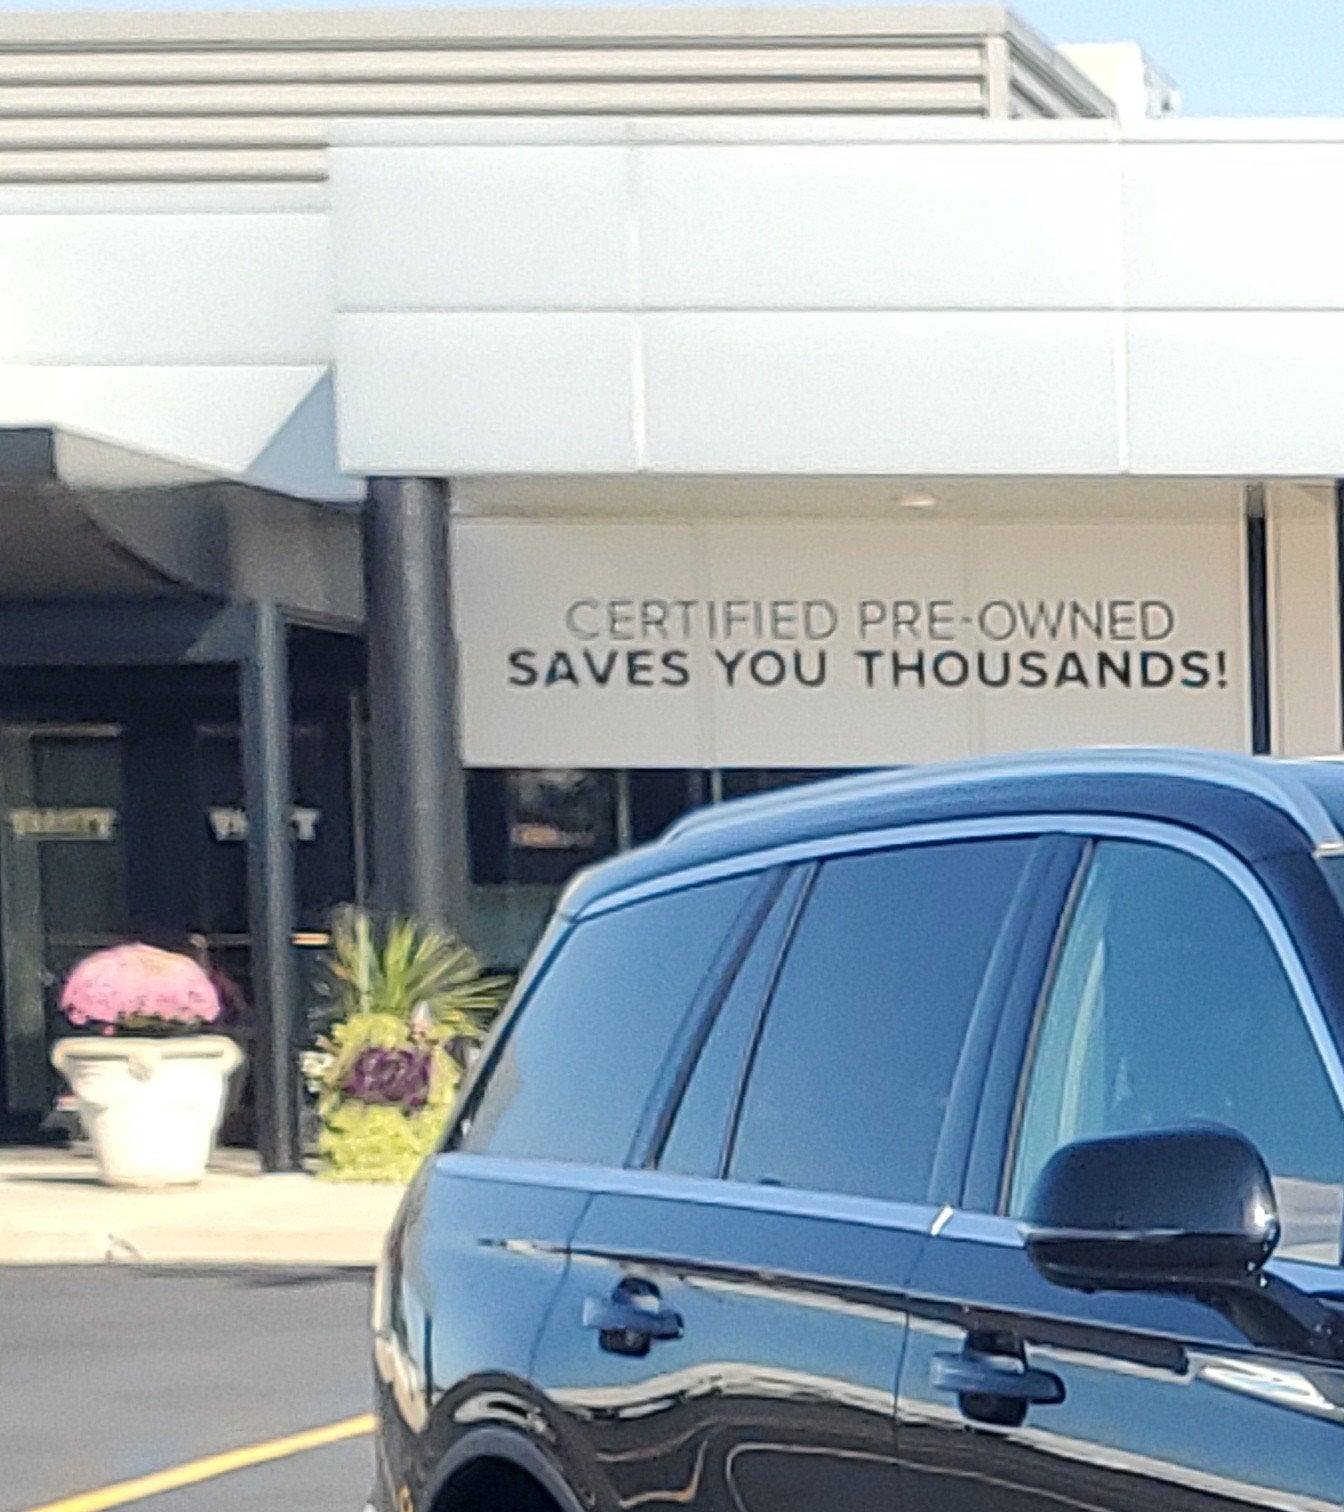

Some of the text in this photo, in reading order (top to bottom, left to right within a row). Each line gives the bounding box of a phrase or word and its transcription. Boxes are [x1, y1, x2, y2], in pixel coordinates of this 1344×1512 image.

[565, 599, 1175, 641] CERTIFIED PRE-OWNED
[508, 649, 1228, 688] SAVES YOU THOUSANDS!
